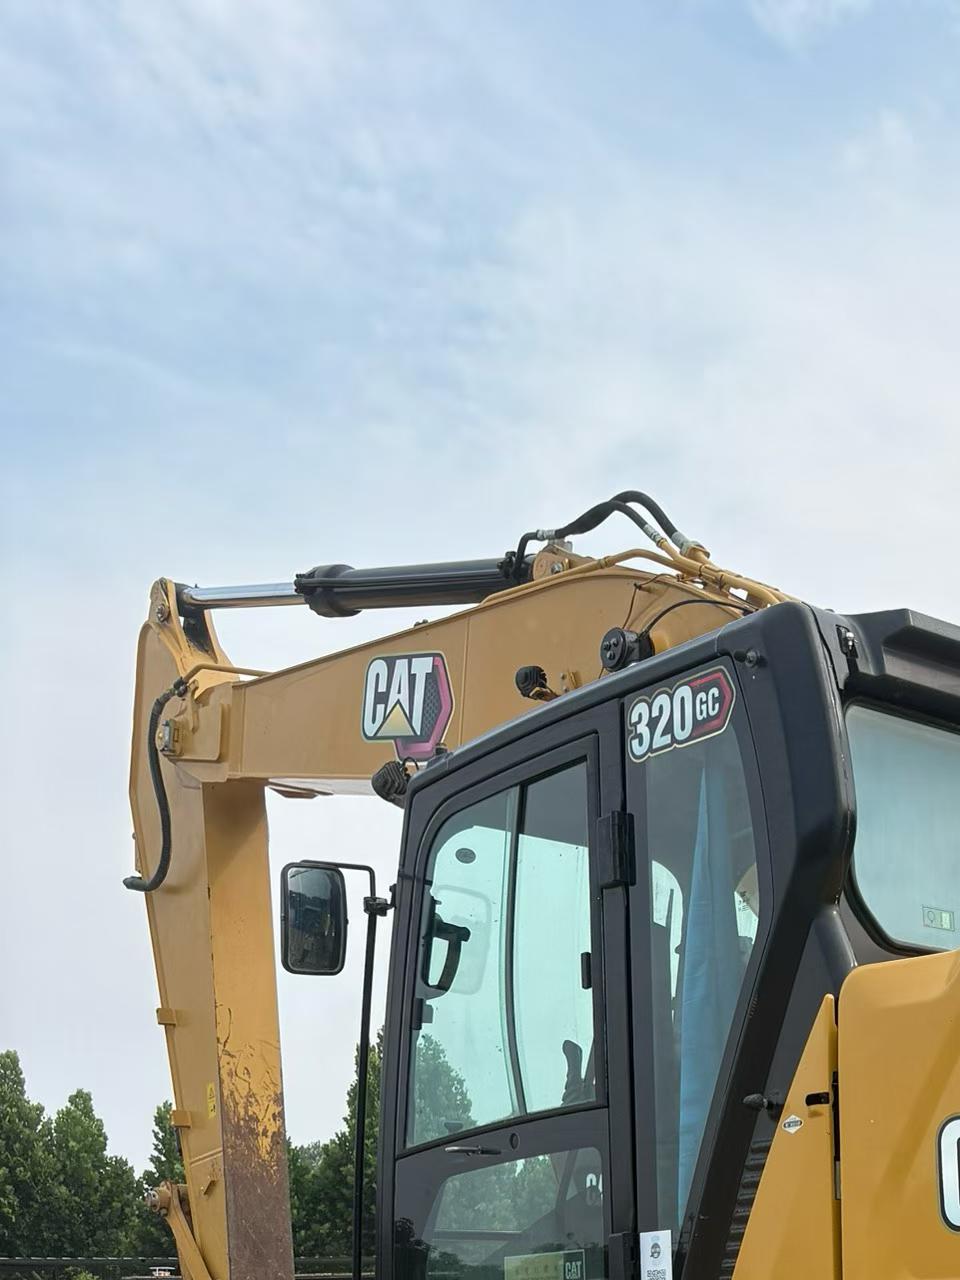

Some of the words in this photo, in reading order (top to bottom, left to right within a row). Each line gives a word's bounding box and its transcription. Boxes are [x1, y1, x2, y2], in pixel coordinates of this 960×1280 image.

[364, 656, 433, 737] CAT
[631, 685, 693, 756] 320
[696, 687, 719, 720] GC
[565, 1261, 582, 1280] CAT
